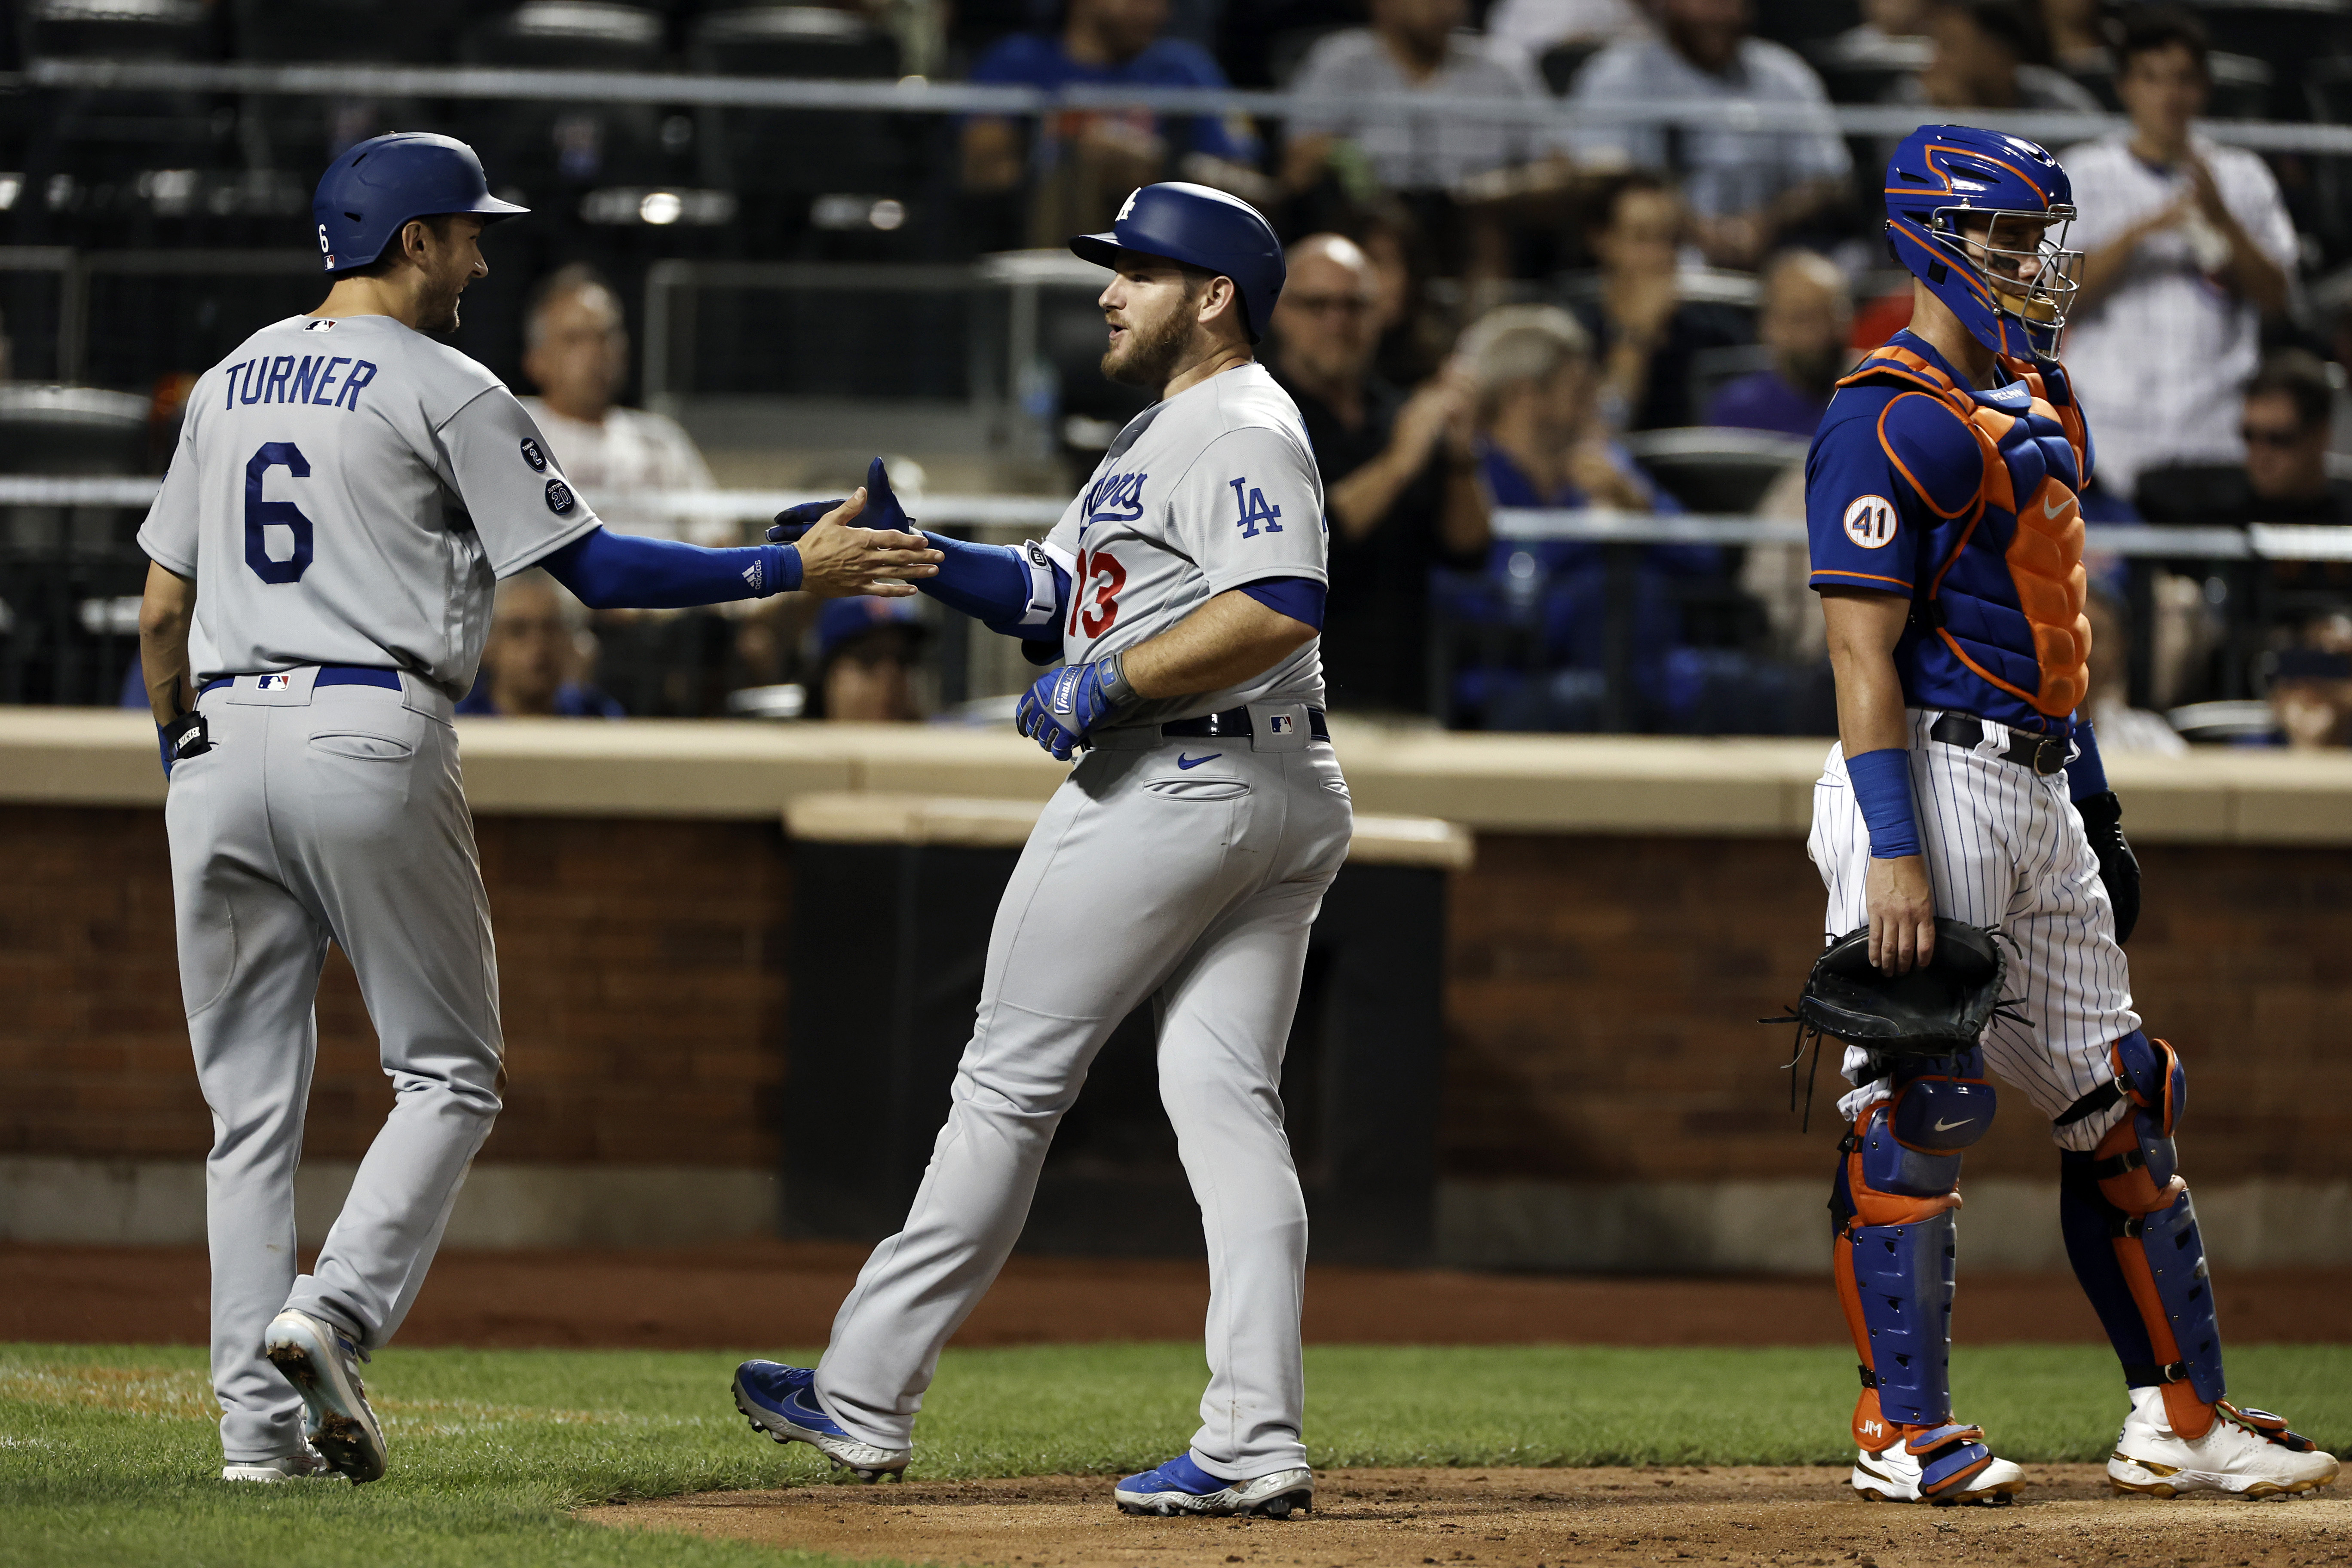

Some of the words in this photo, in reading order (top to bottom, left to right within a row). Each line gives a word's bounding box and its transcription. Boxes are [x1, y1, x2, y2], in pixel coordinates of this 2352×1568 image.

[318, 224, 329, 253] 6
[226, 355, 378, 412] TURNER
[522, 441, 535, 451] TOMMY
[529, 448, 543, 466] 2
[548, 481, 563, 494] SUTTON
[551, 487, 572, 510] 20
[245, 441, 313, 585] 6
[1229, 477, 1283, 539] LA
[1852, 505, 1887, 539] 41
[754, 560, 762, 590] adidas
[1068, 548, 1127, 639] 13
[1858, 1419, 1883, 1439] JM
